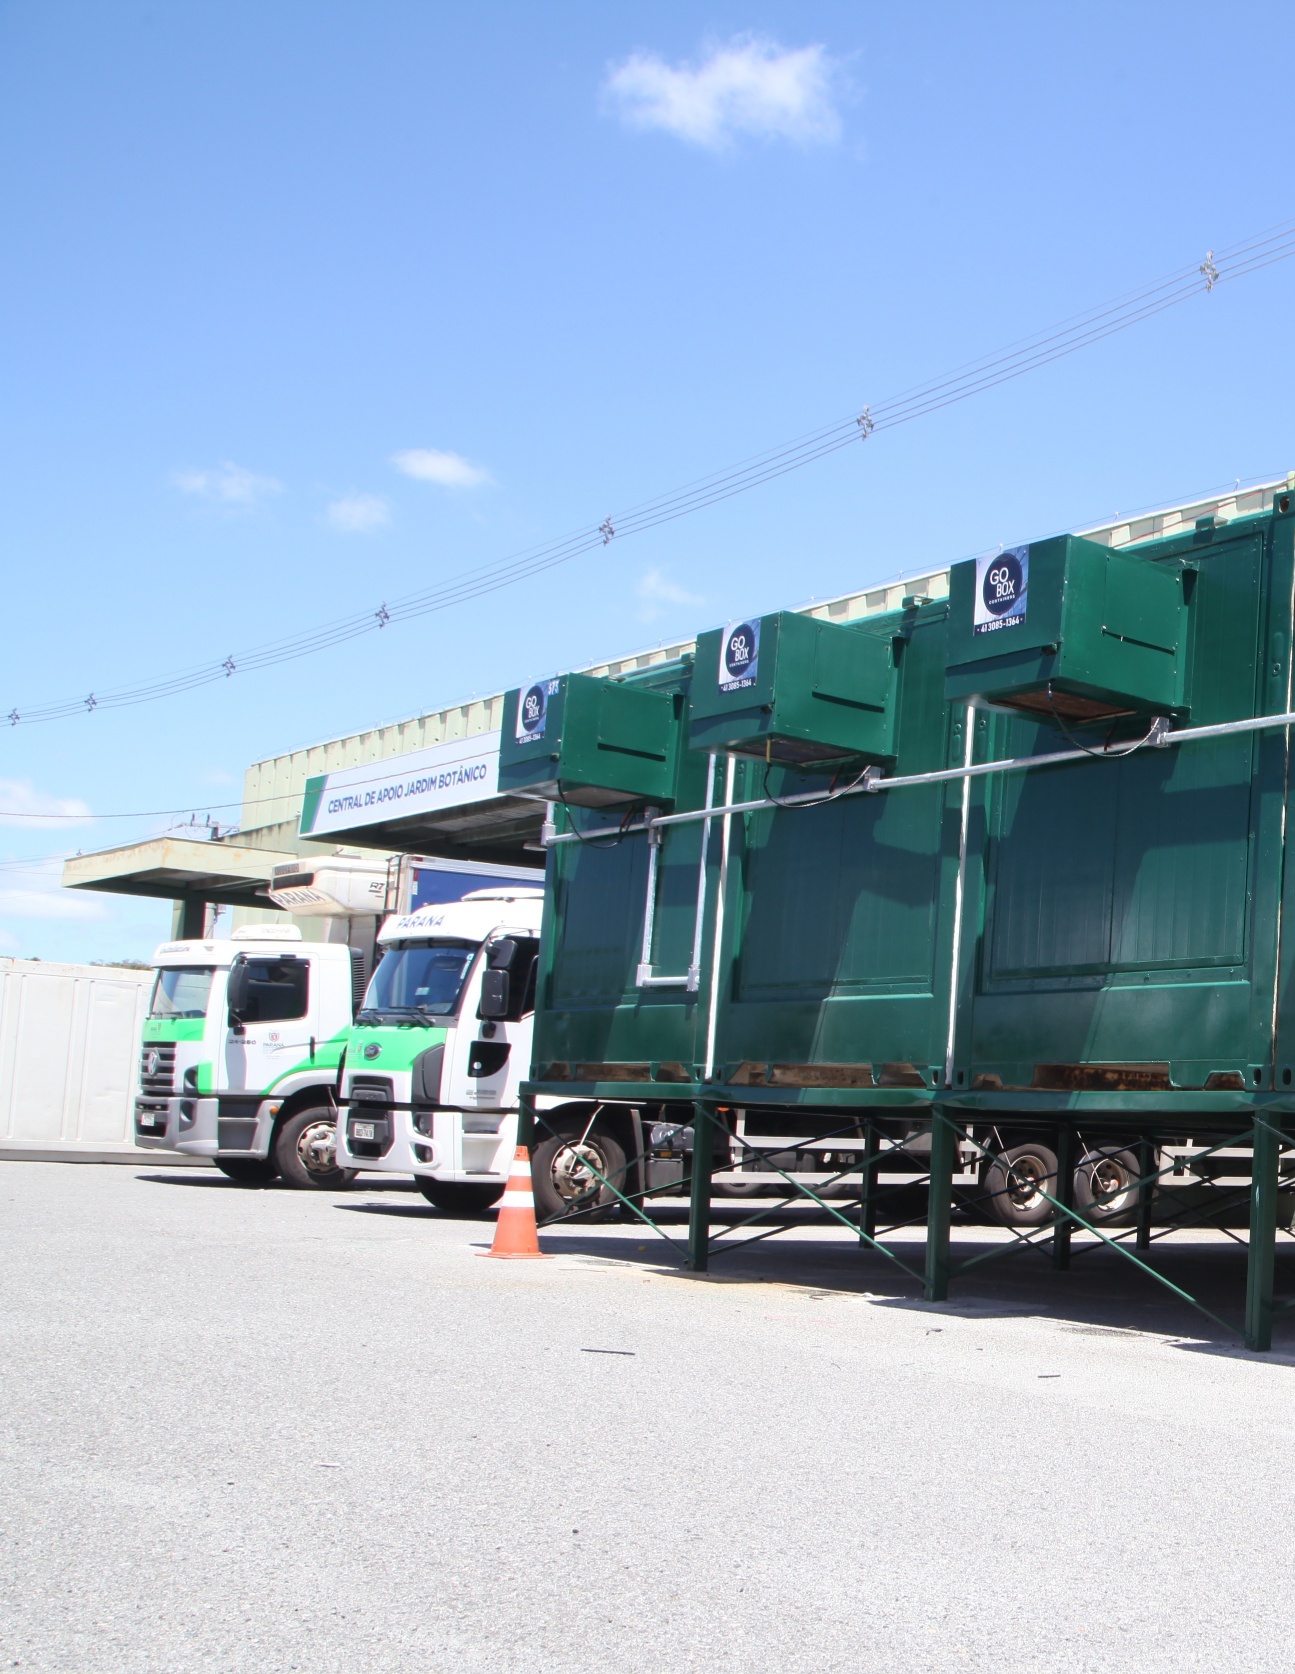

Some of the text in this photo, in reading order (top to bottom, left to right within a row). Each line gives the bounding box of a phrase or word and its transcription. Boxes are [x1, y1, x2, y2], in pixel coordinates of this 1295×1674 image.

[990, 567, 1009, 585] GO
[996, 580, 1015, 598] BOX
[731, 636, 745, 650] GO
[735, 647, 749, 661] BOX
[526, 696, 537, 708] GO
[528, 706, 540, 718] BOX
[328, 763, 487, 814] CENTRAL DE APOIO JARDIM BOTÂNICO
